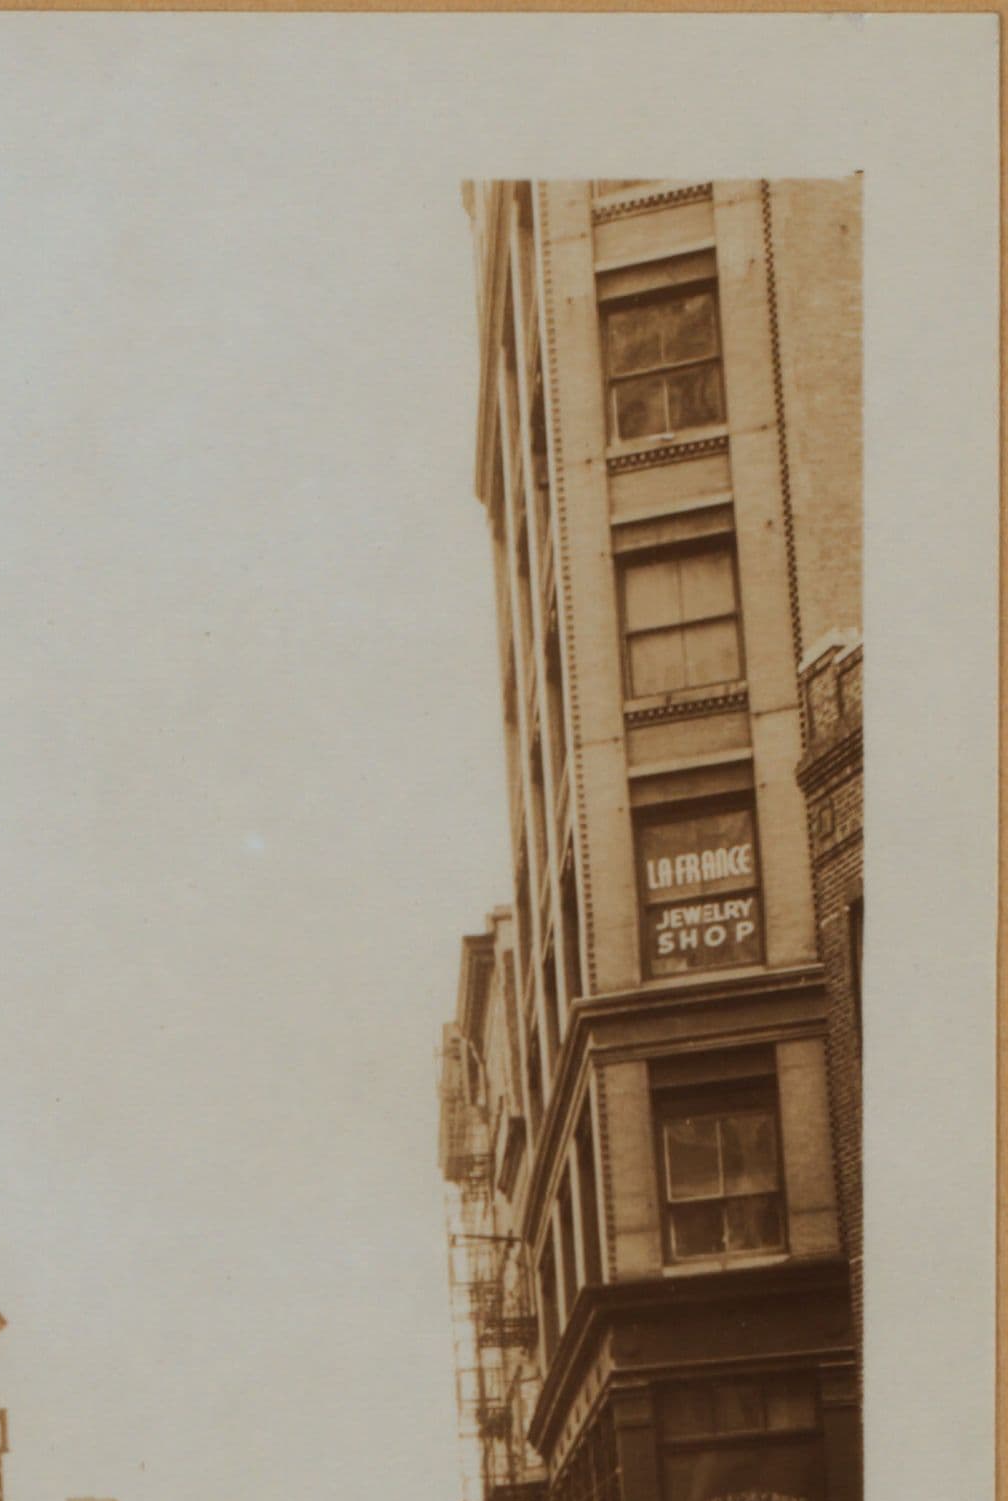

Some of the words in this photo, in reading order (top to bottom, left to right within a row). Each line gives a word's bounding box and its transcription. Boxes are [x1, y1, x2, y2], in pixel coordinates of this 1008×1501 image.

[647, 857, 672, 889] LA
[675, 844, 752, 887] FRANCE
[656, 898, 754, 931] JEWELRY
[658, 921, 755, 955] SHOP
